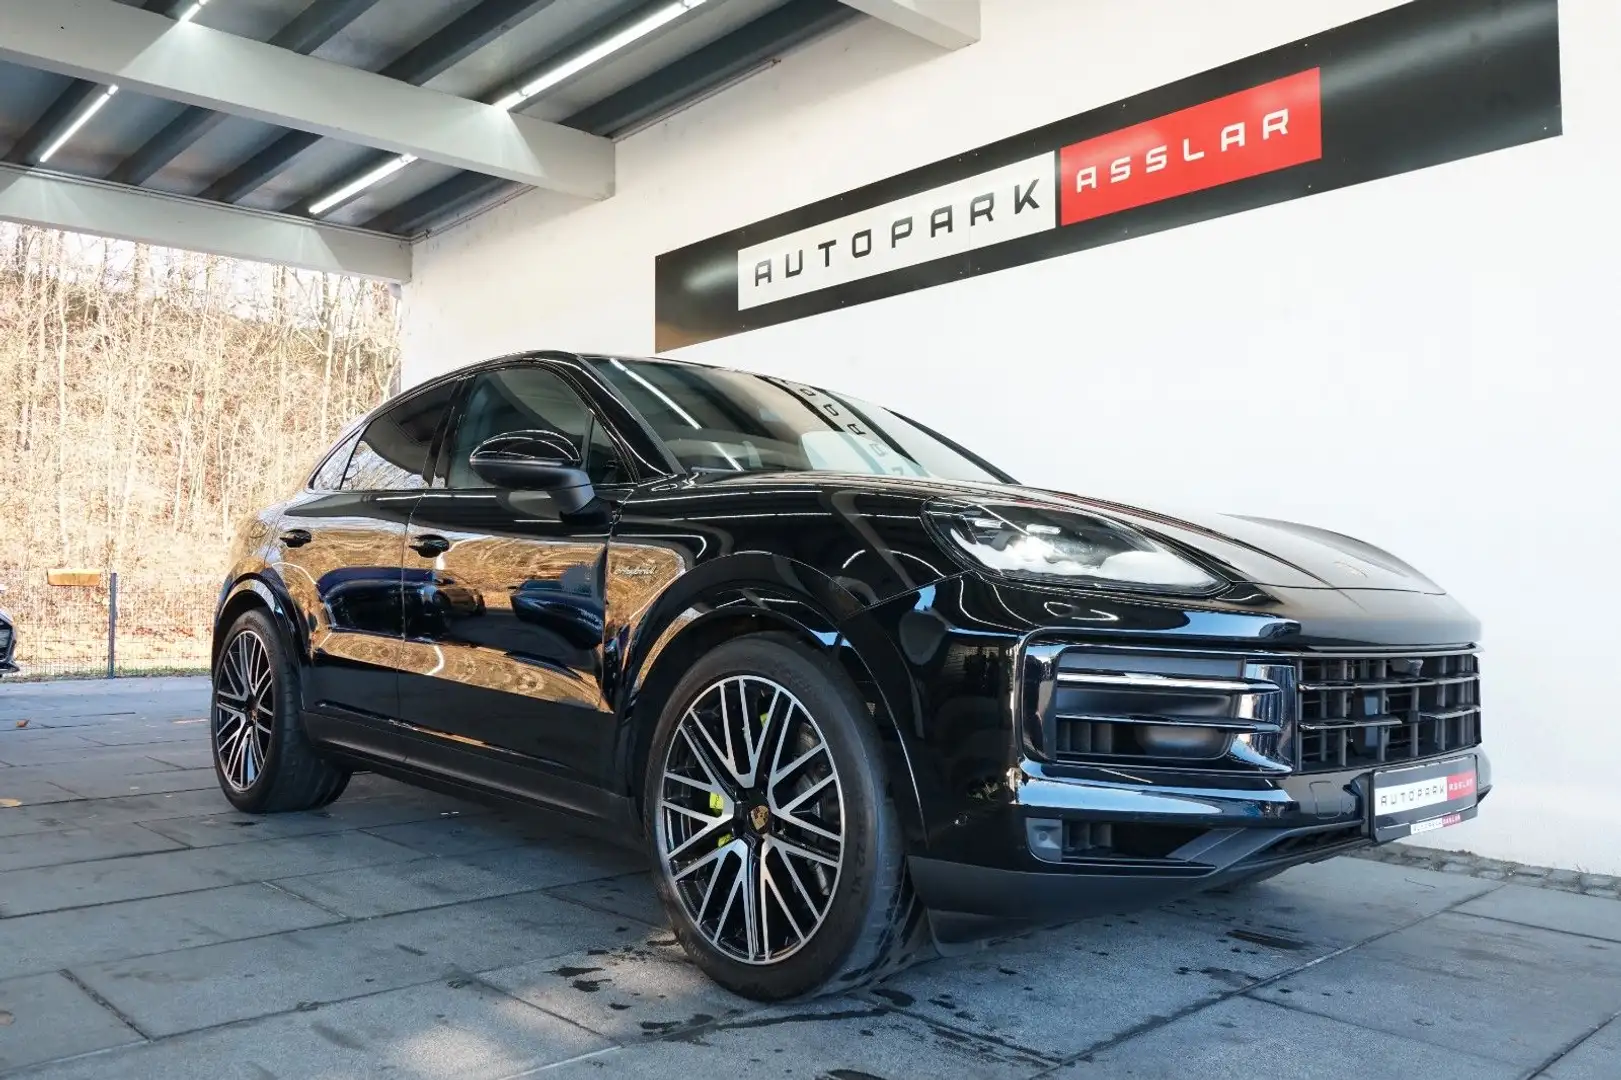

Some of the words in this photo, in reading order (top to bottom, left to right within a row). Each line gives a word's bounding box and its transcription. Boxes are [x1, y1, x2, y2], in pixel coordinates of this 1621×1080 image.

[754, 178, 1040, 287] AUTOPARK
[1076, 108, 1289, 193] ASSLAR
[1380, 783, 1445, 806] AUTOPARK
